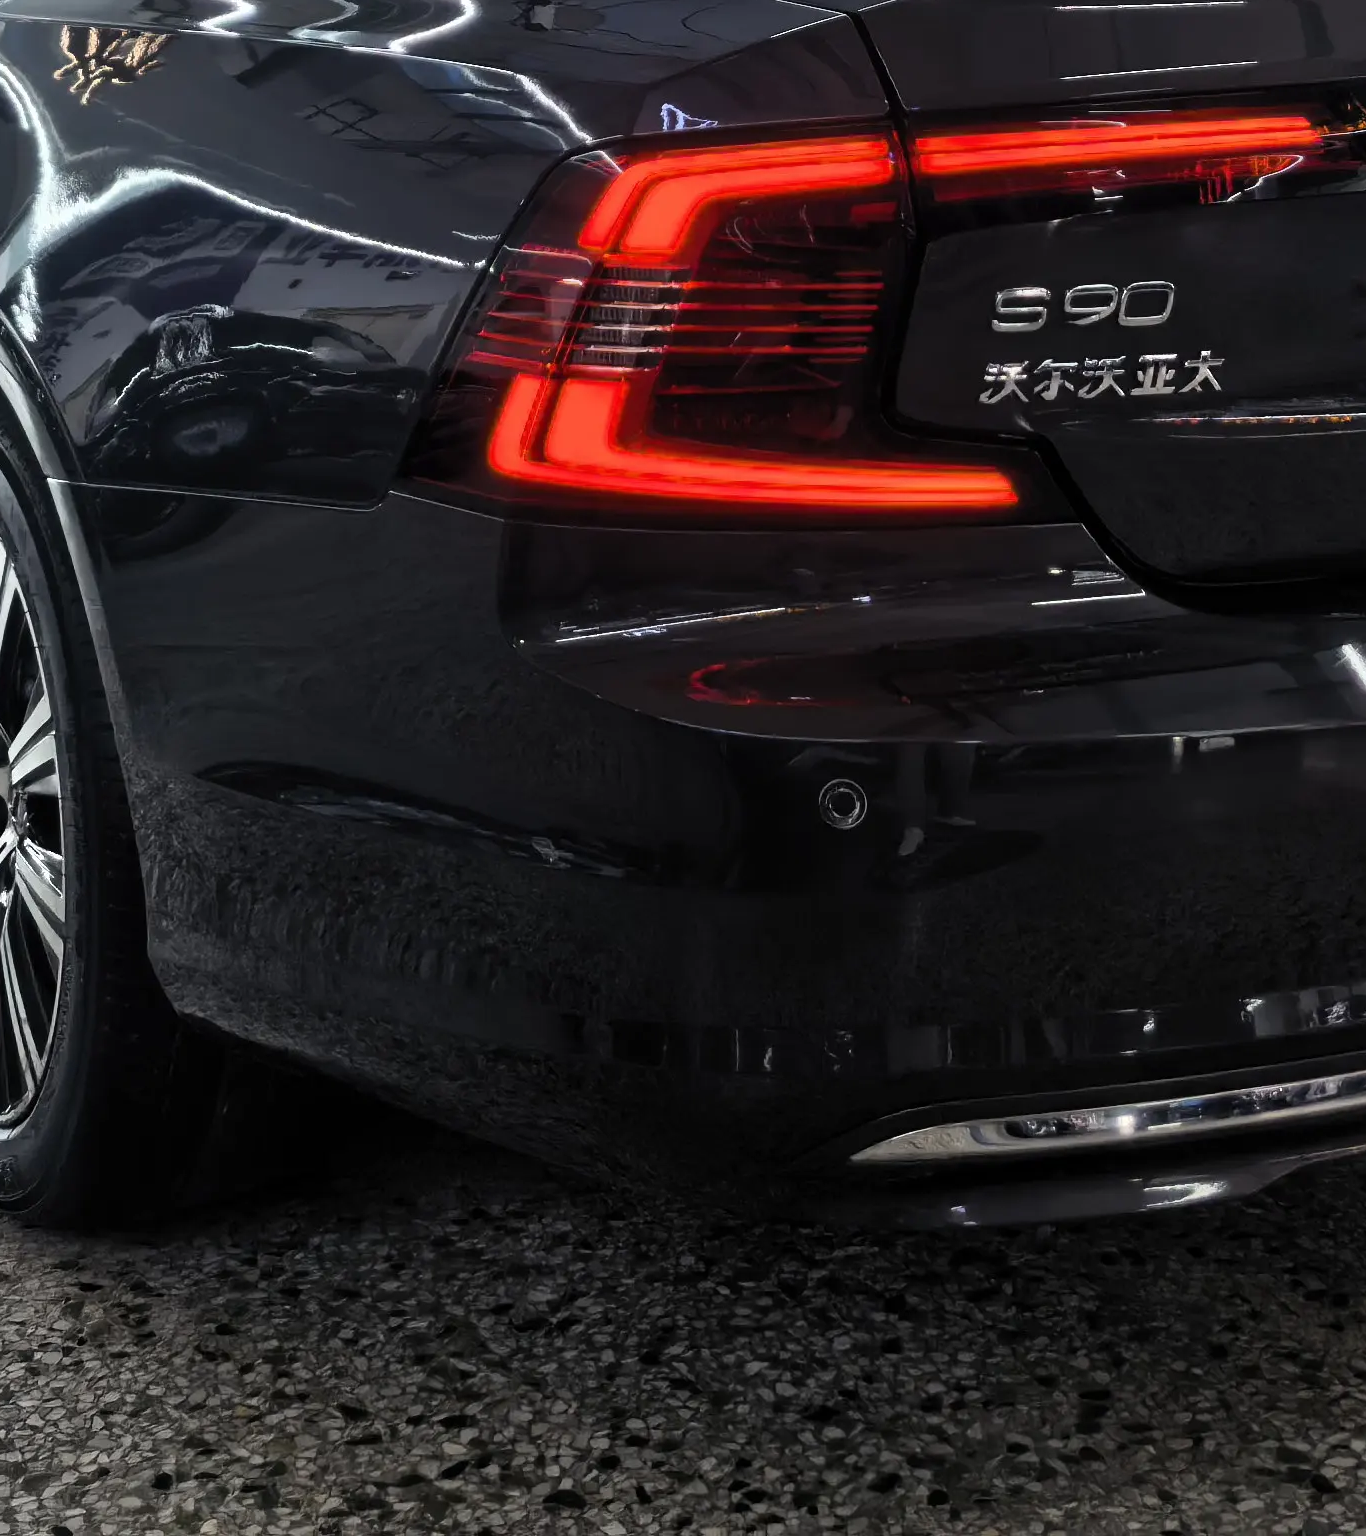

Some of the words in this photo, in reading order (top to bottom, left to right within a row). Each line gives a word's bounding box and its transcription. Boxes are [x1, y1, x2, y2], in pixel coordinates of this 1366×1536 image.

[991, 280, 1175, 332] S90
[979, 350, 1226, 404] 沃尔沃亚太
